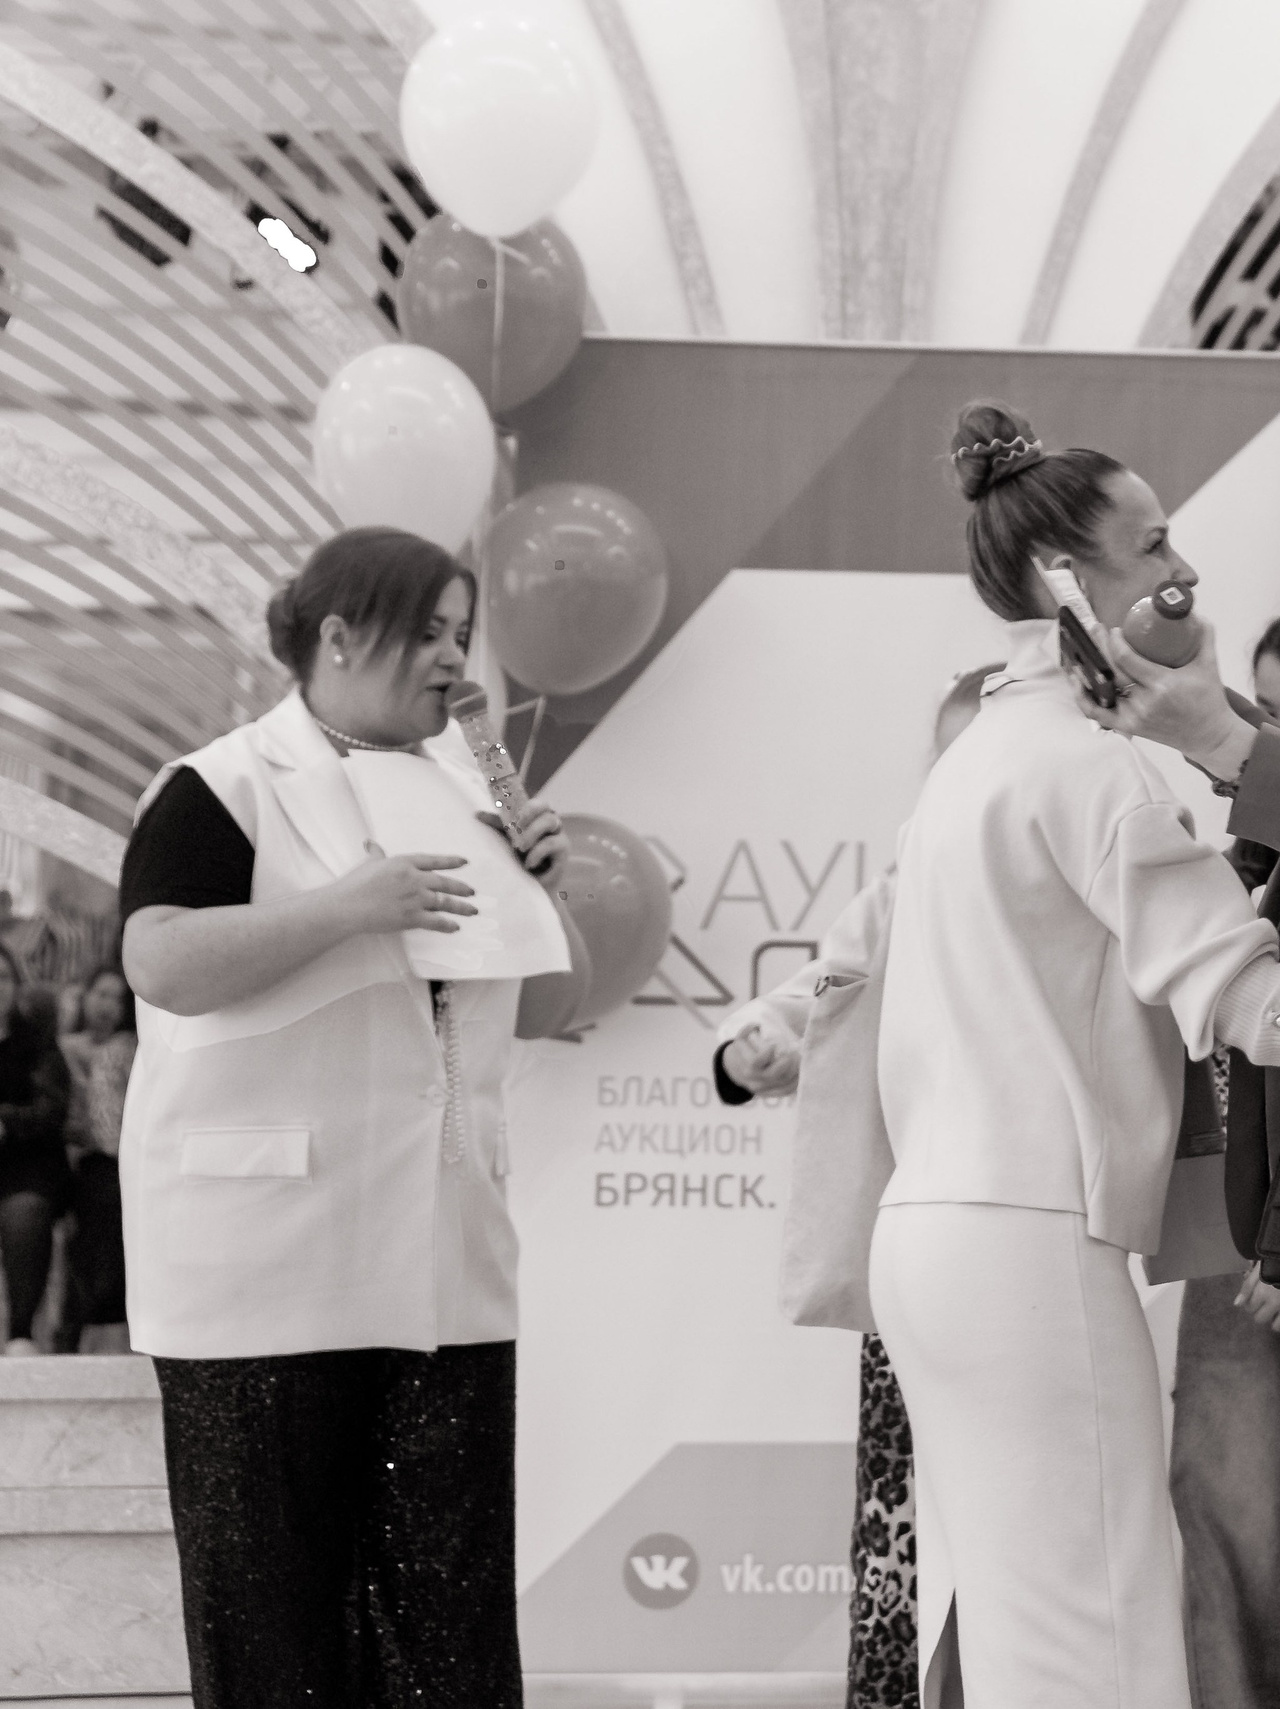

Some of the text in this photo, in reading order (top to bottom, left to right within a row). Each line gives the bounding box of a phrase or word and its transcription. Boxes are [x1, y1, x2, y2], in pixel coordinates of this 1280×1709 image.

[595, 1123, 763, 1158] АУКЦИОН
[594, 1171, 777, 1209] БРЯНСК.
[719, 1552, 851, 1595] vk.com
